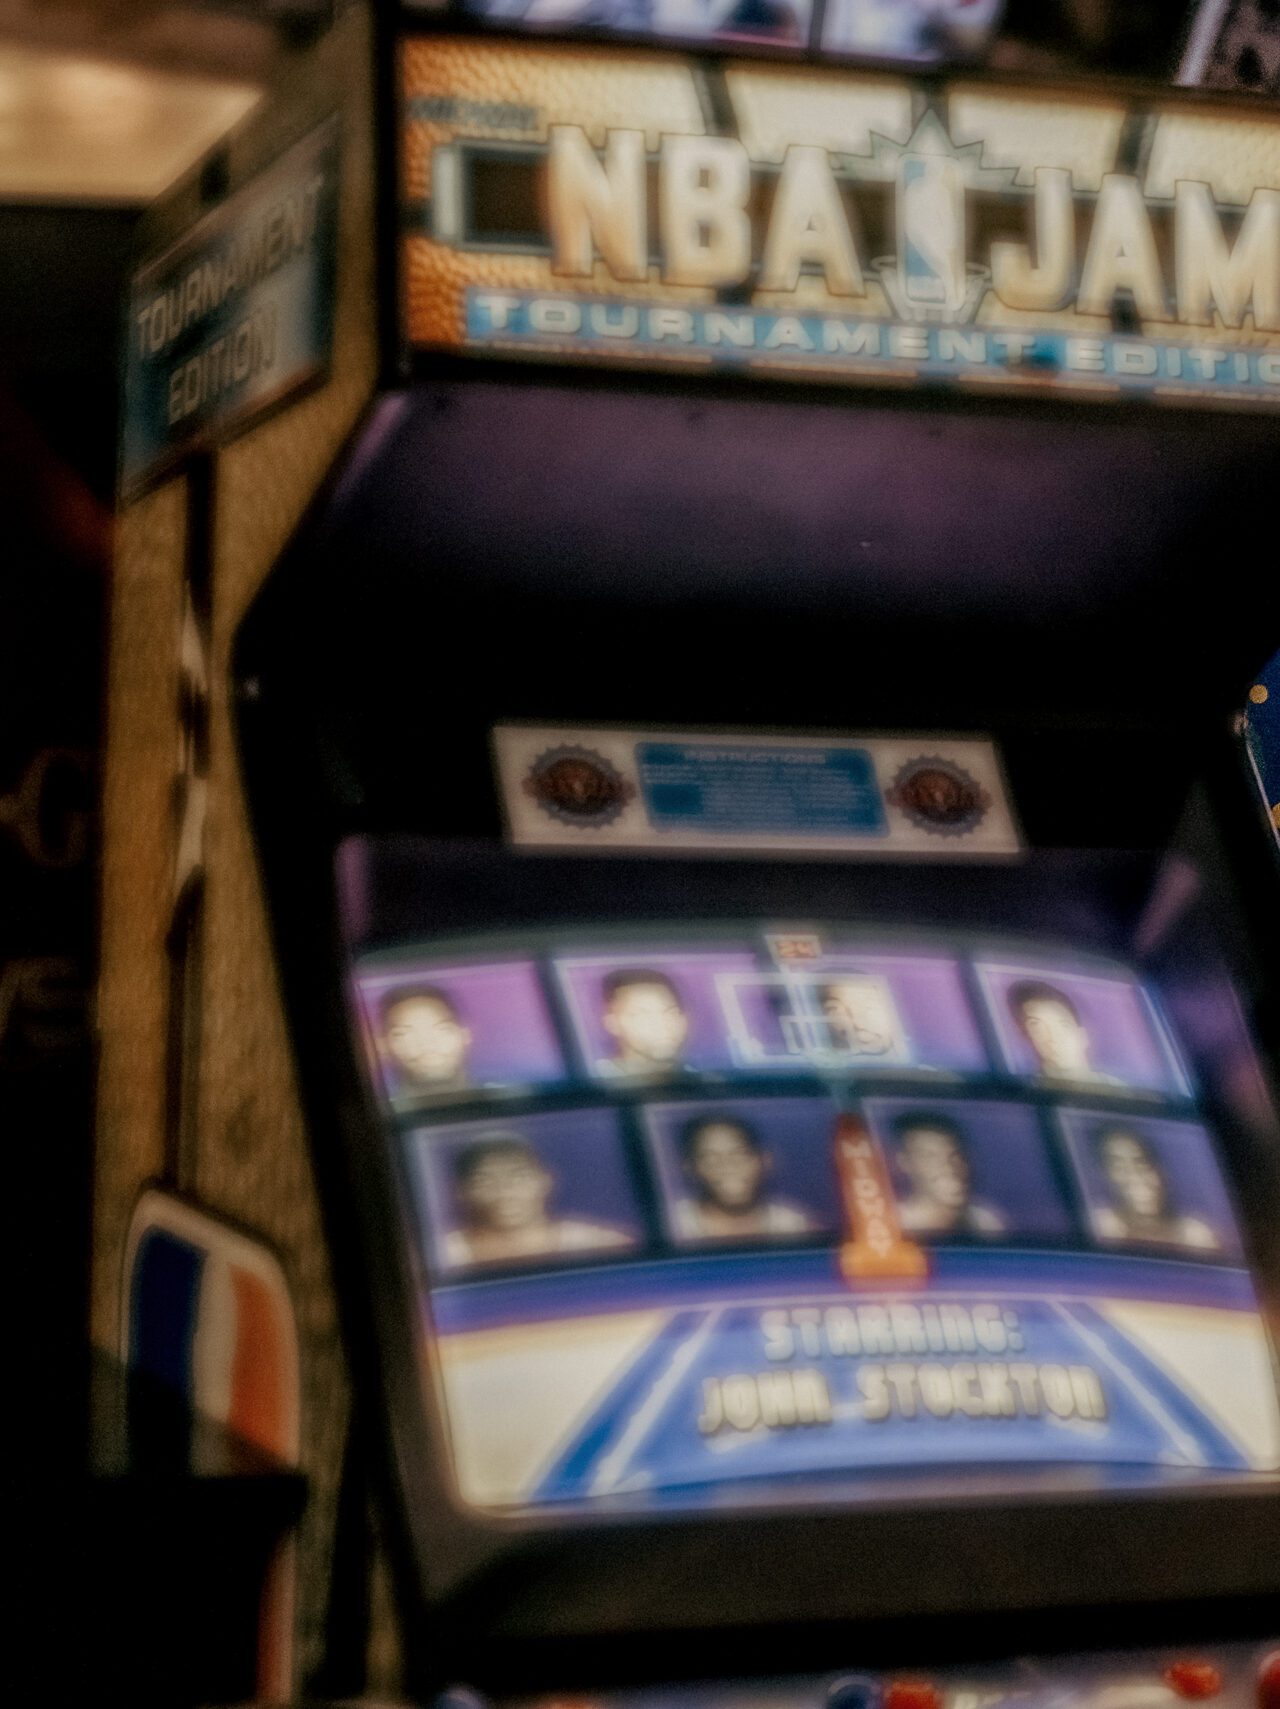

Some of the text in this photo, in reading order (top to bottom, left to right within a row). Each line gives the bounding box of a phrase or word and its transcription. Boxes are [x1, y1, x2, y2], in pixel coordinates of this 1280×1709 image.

[544, 122, 870, 300] NBA
[167, 304, 281, 427] EDITION
[474, 294, 1036, 366] TOURNAMENT
[698, 1362, 1107, 1435] JOHN STOCKTON
